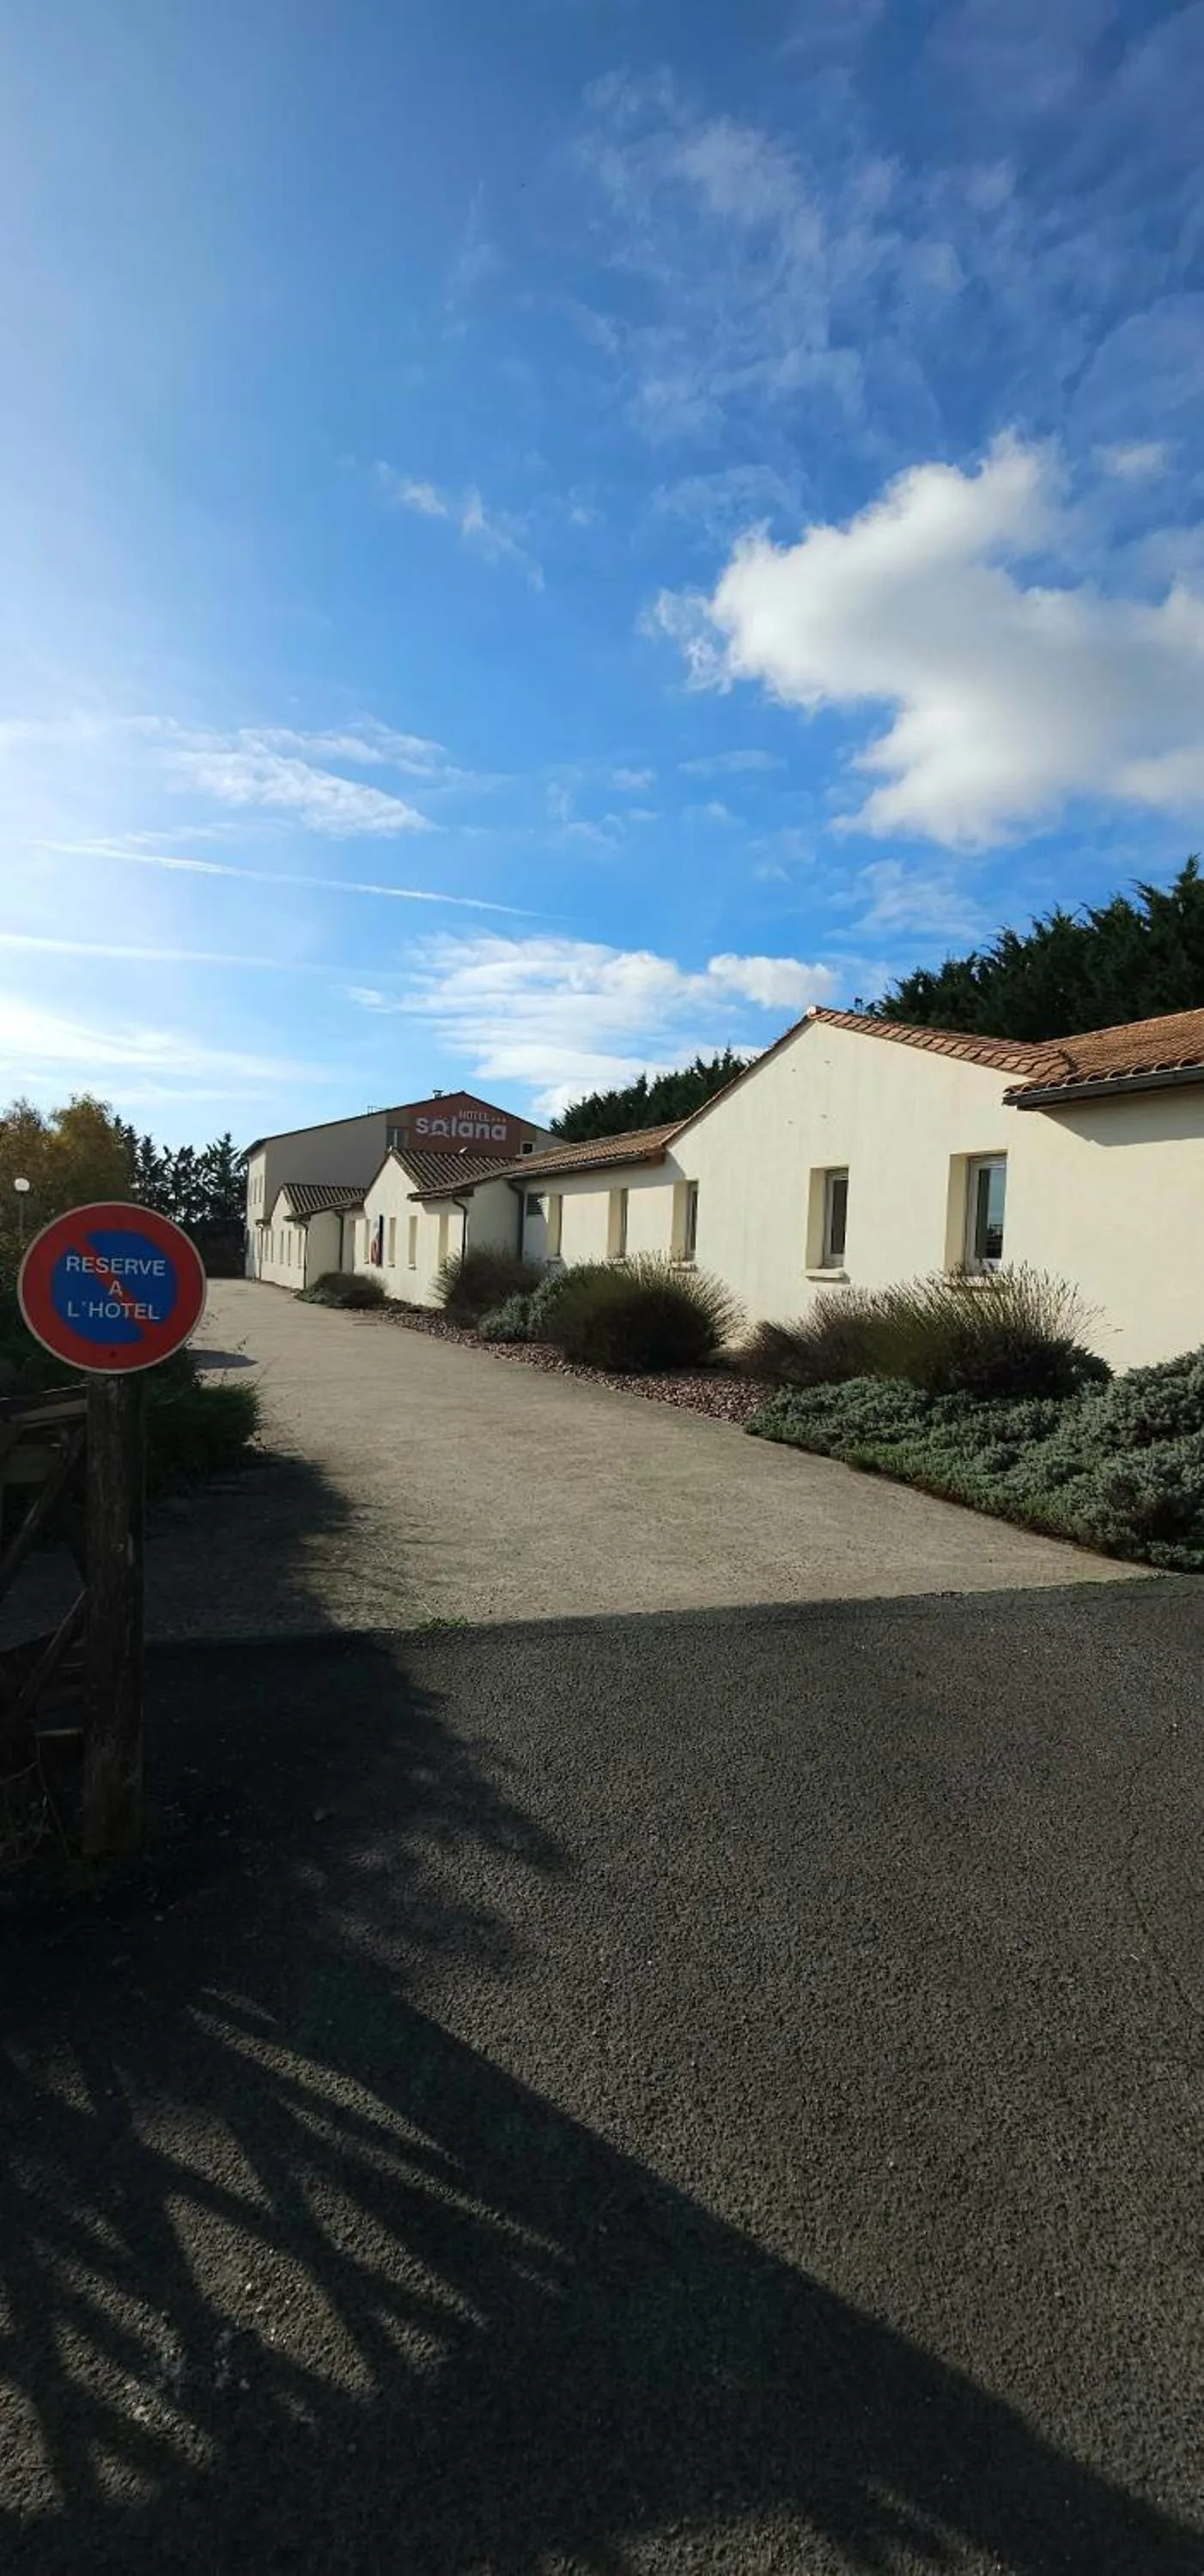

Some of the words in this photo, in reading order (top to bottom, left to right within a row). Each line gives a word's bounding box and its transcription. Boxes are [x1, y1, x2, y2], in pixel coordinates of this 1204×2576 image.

[458, 1109, 490, 1121] HOTEL
[65, 1255, 166, 1277] RESERVE
[109, 1279, 123, 1297] A
[67, 1301, 161, 1320] L'HOTEL
